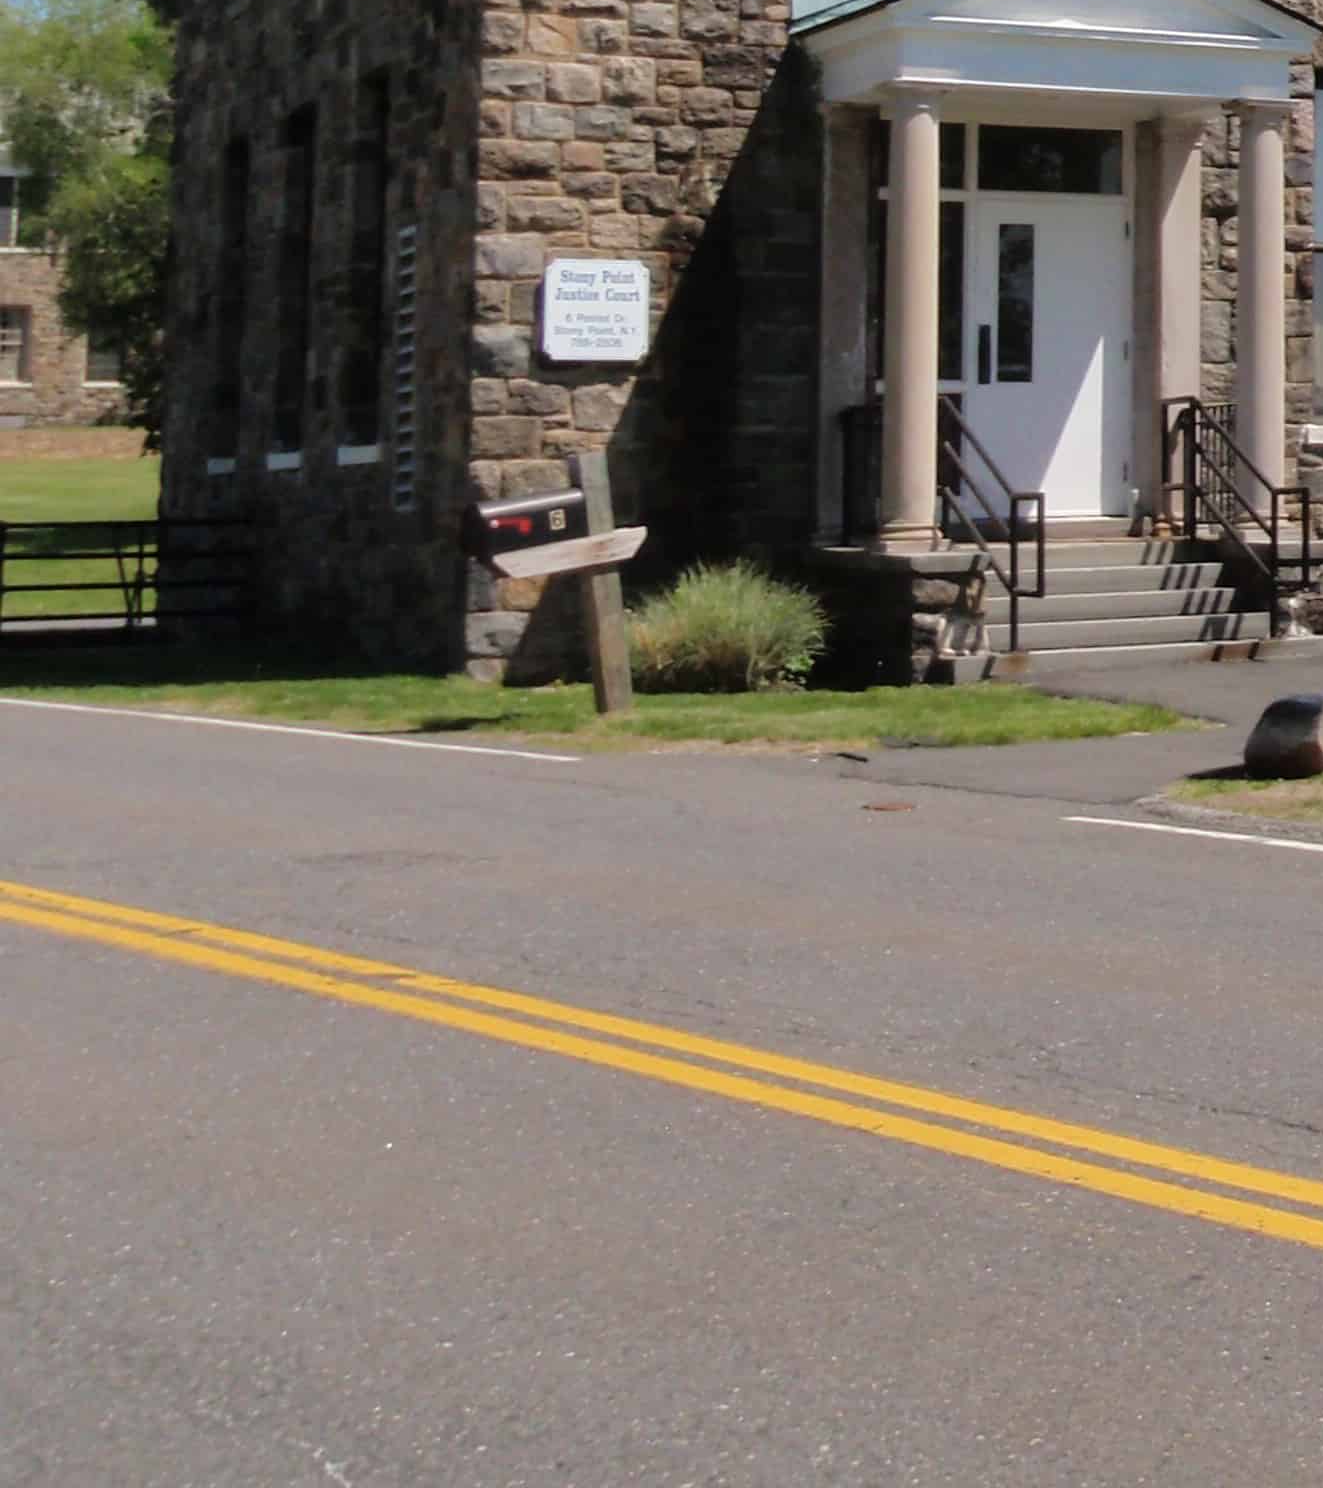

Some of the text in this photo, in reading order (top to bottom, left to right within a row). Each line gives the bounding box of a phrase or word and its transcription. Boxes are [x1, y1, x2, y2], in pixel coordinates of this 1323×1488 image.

[560, 270, 635, 287] Stony Point
[555, 288, 641, 303] Justice Court
